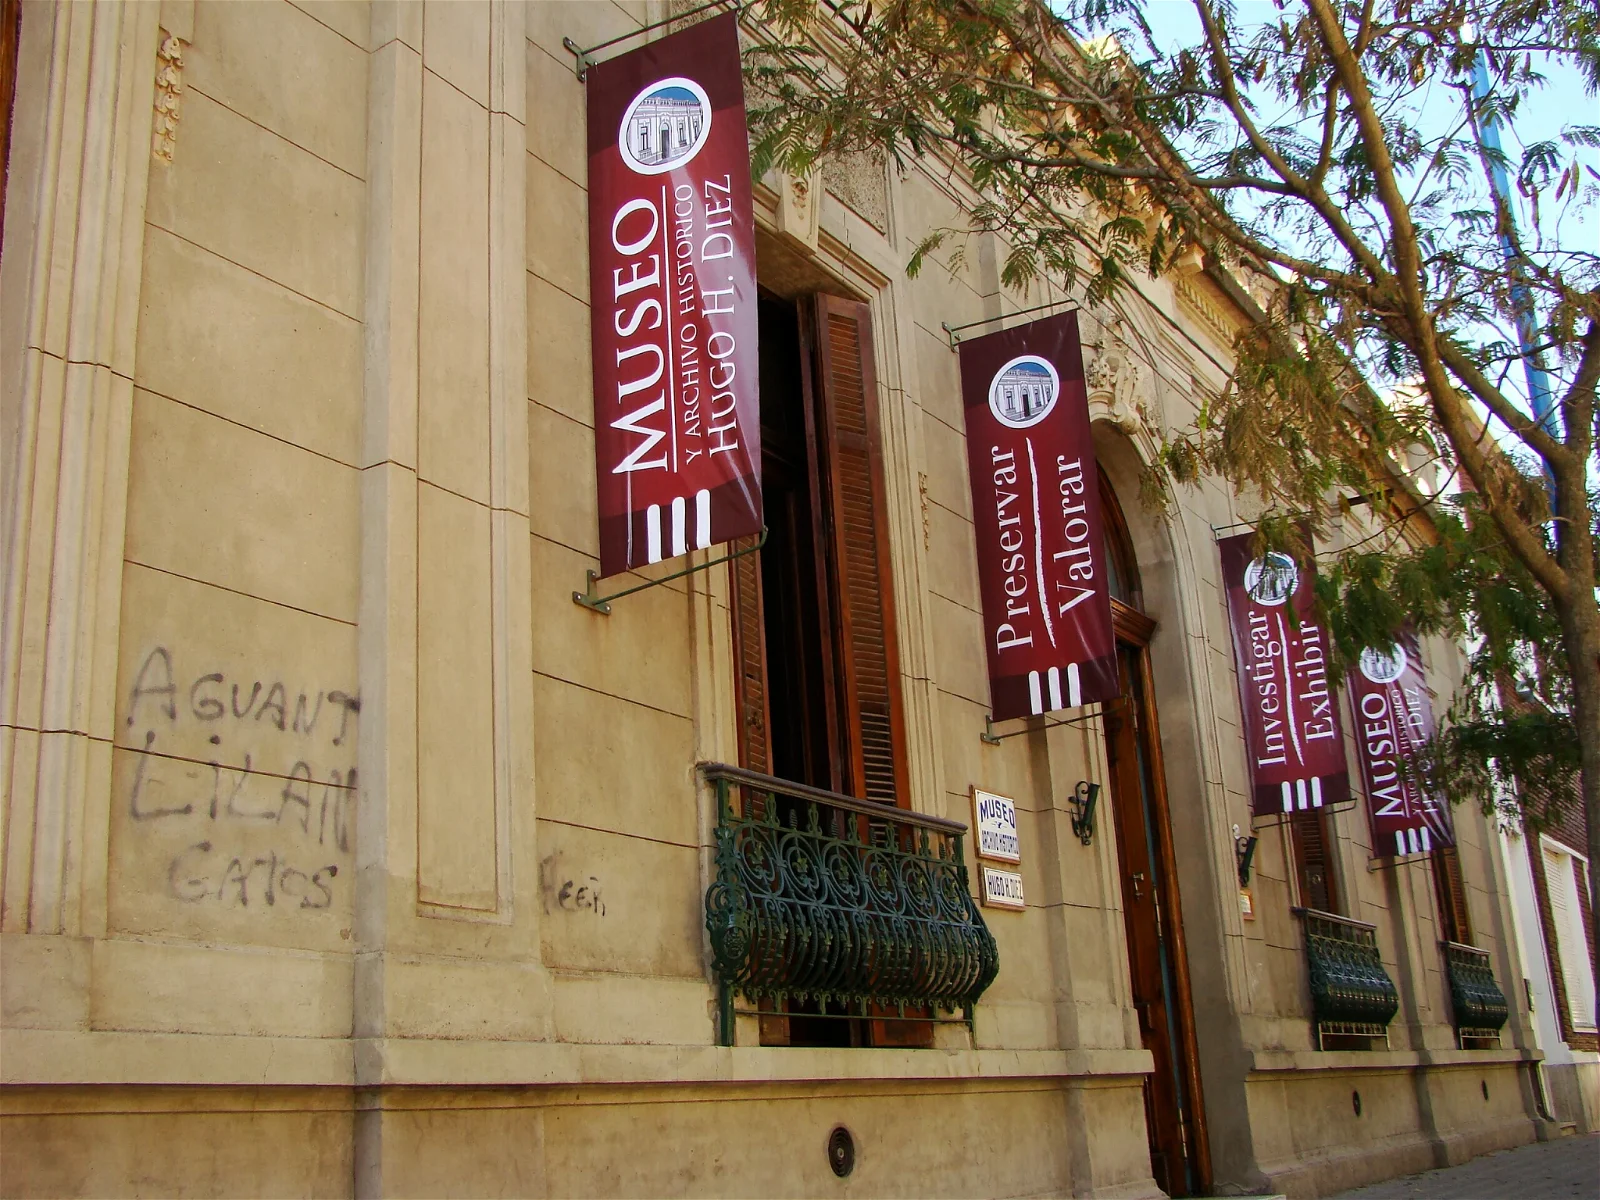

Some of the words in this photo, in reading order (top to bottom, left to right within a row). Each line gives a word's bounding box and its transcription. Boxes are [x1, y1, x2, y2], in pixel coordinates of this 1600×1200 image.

[674, 184, 695, 316] HISTORICO
[700, 174, 734, 264] DIEZ
[611, 198, 669, 475] MUSEO
[701, 275, 736, 319] H.
[680, 323, 701, 438] ARCHIVO
[707, 331, 739, 458] HUGO
[686, 448, 702, 465] Y
[991, 445, 1034, 655] Preservar
[1053, 455, 1096, 619] Valorar
[1245, 610, 1287, 769] Investigar
[1291, 620, 1335, 742] Exhibir
[1406, 686, 1425, 728] DIEZ
[979, 799, 1016, 829] MUSEO
[1361, 692, 1406, 817] MUSEO
[168, 841, 338, 909] GATOS
